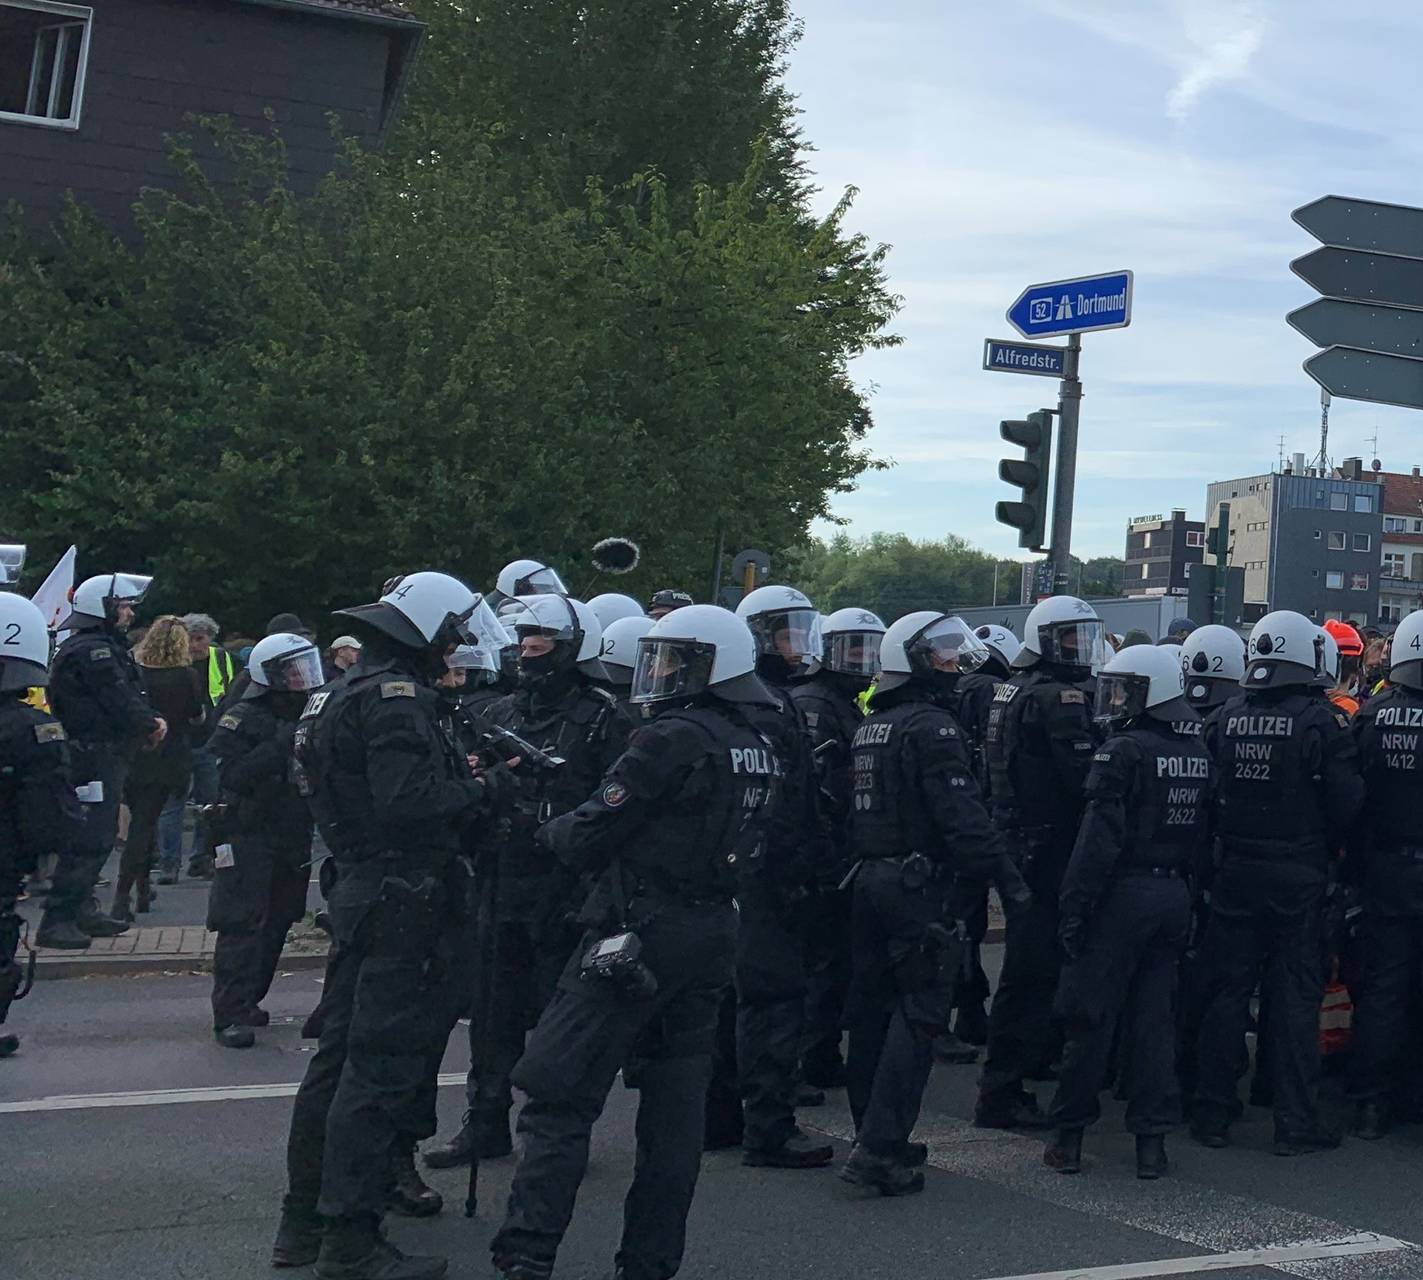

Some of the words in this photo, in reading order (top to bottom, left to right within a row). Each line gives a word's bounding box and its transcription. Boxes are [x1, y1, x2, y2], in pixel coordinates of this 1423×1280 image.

[1035, 303, 1046, 318] 52
[1077, 288, 1126, 316] Dortmund
[996, 348, 1060, 370] Alfredstr.
[395, 584, 414, 600] 4
[4, 623, 21, 645] 2
[993, 633, 1006, 645] 2
[1409, 634, 1421, 651] 4
[605, 639, 616, 655] 2
[1250, 638, 1257, 655] 6
[1274, 637, 1286, 654] 2
[1182, 655, 1190, 672] 6
[1212, 656, 1224, 673] 2
[1225, 716, 1293, 736] POLIZEI
[1382, 734, 1418, 751] NRW
[1235, 743, 1272, 760] NRW
[1156, 757, 1209, 779] POLIZEI
[1385, 753, 1416, 770] 1412
[1235, 763, 1271, 781] 2622
[1168, 788, 1200, 804] NRW
[1167, 808, 1196, 824] 2622
